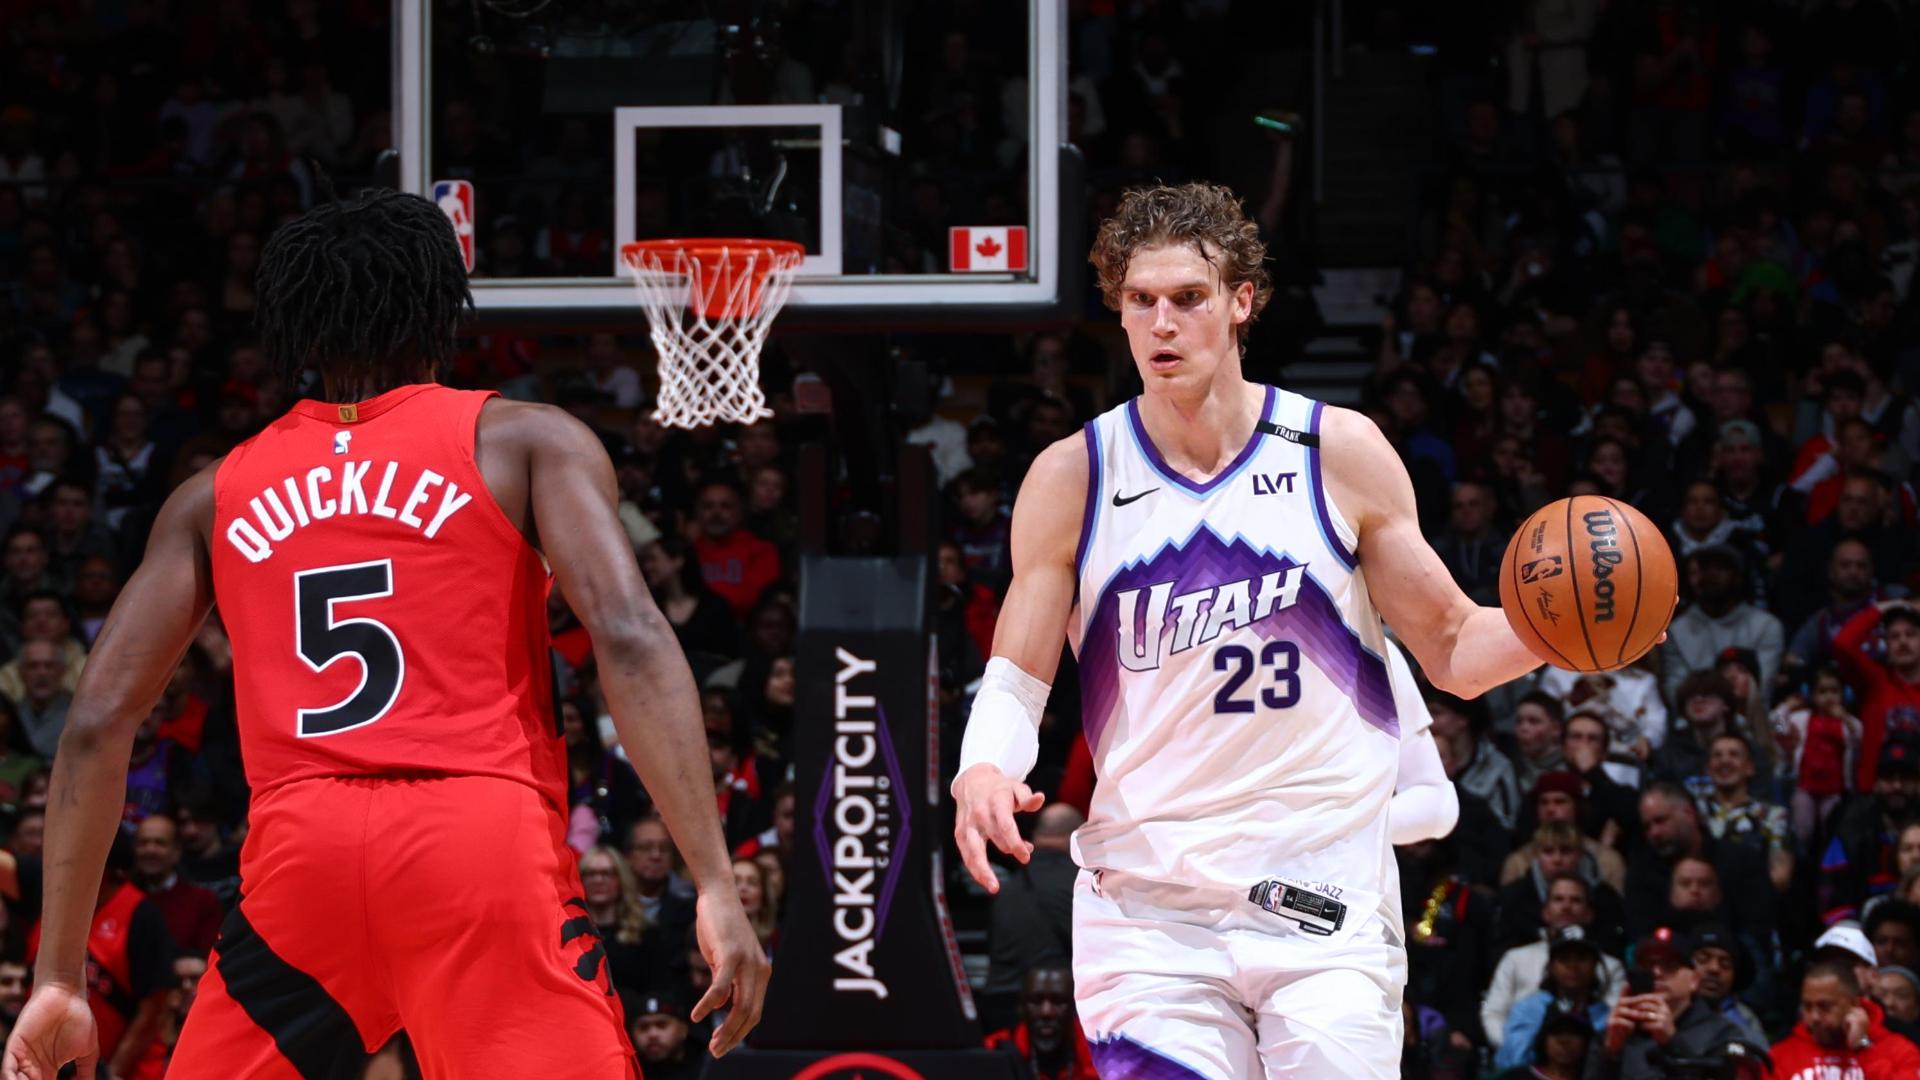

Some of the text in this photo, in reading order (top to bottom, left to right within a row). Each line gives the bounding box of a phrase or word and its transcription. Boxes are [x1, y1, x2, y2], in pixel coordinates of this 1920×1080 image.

[1275, 425, 1300, 443] FRANK
[226, 460, 472, 564] QUICKLEY
[1252, 472, 1297, 496] LVT
[1583, 509, 1623, 624] Wilson
[294, 558, 405, 738] 5
[1213, 640, 1301, 714] 23
[833, 646, 888, 999] JACKPOTCITY
[877, 775, 889, 868] CASINO
